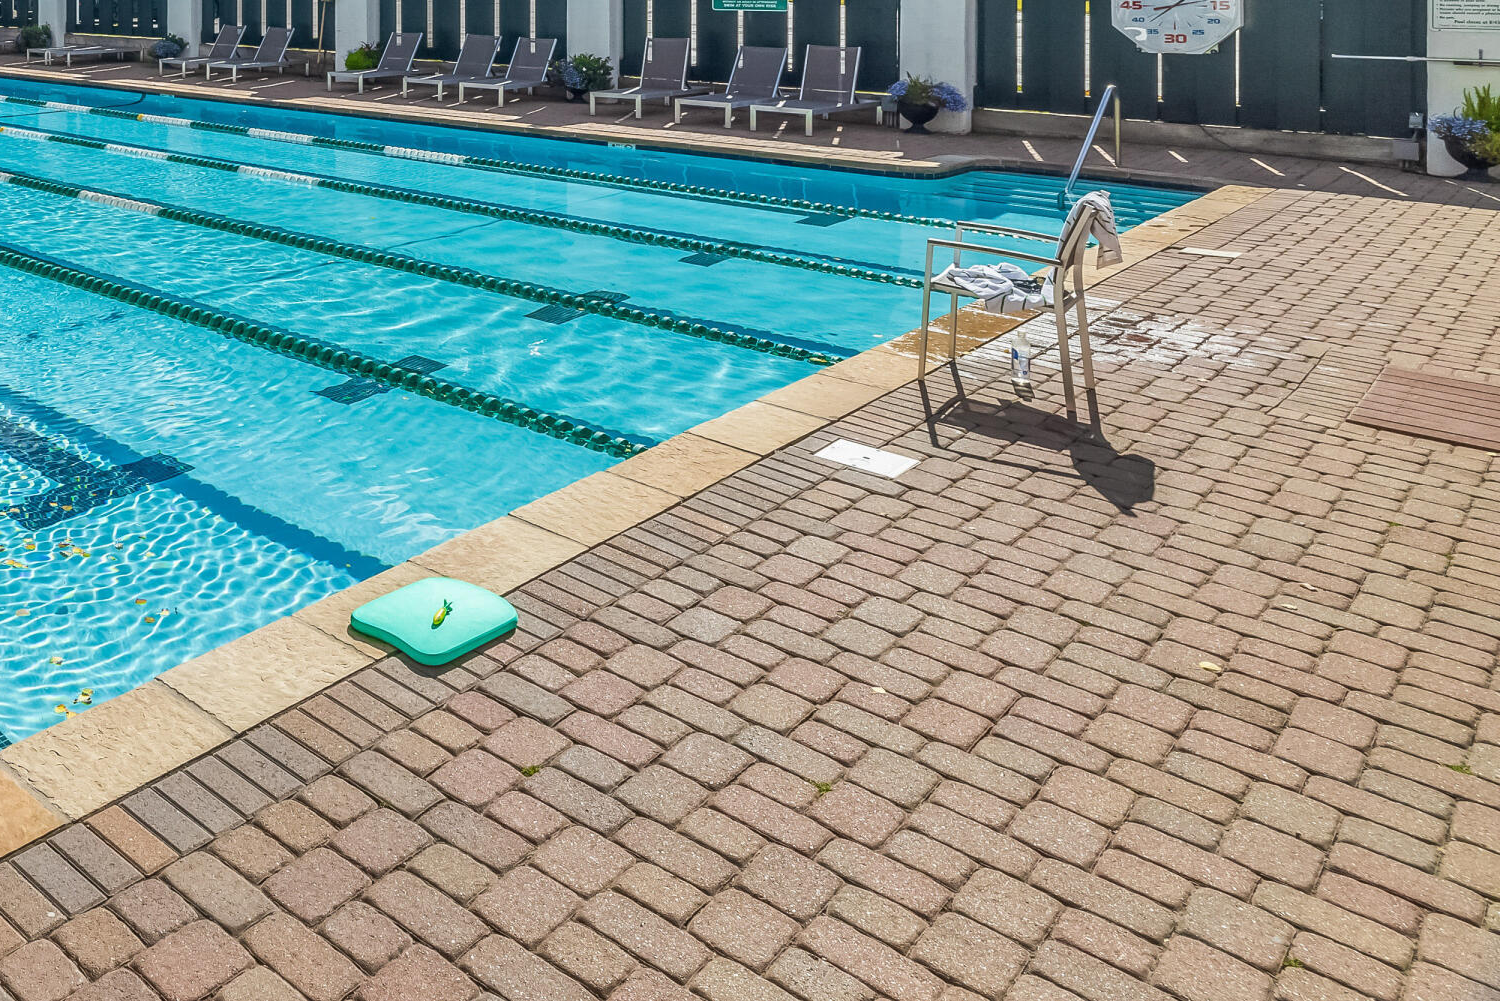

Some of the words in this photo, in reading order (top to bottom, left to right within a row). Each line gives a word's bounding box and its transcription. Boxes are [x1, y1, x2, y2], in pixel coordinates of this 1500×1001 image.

[1120, 0, 1143, 10] 45
[1209, 0, 1231, 10] 15
[1163, 34, 1187, 44] 30
